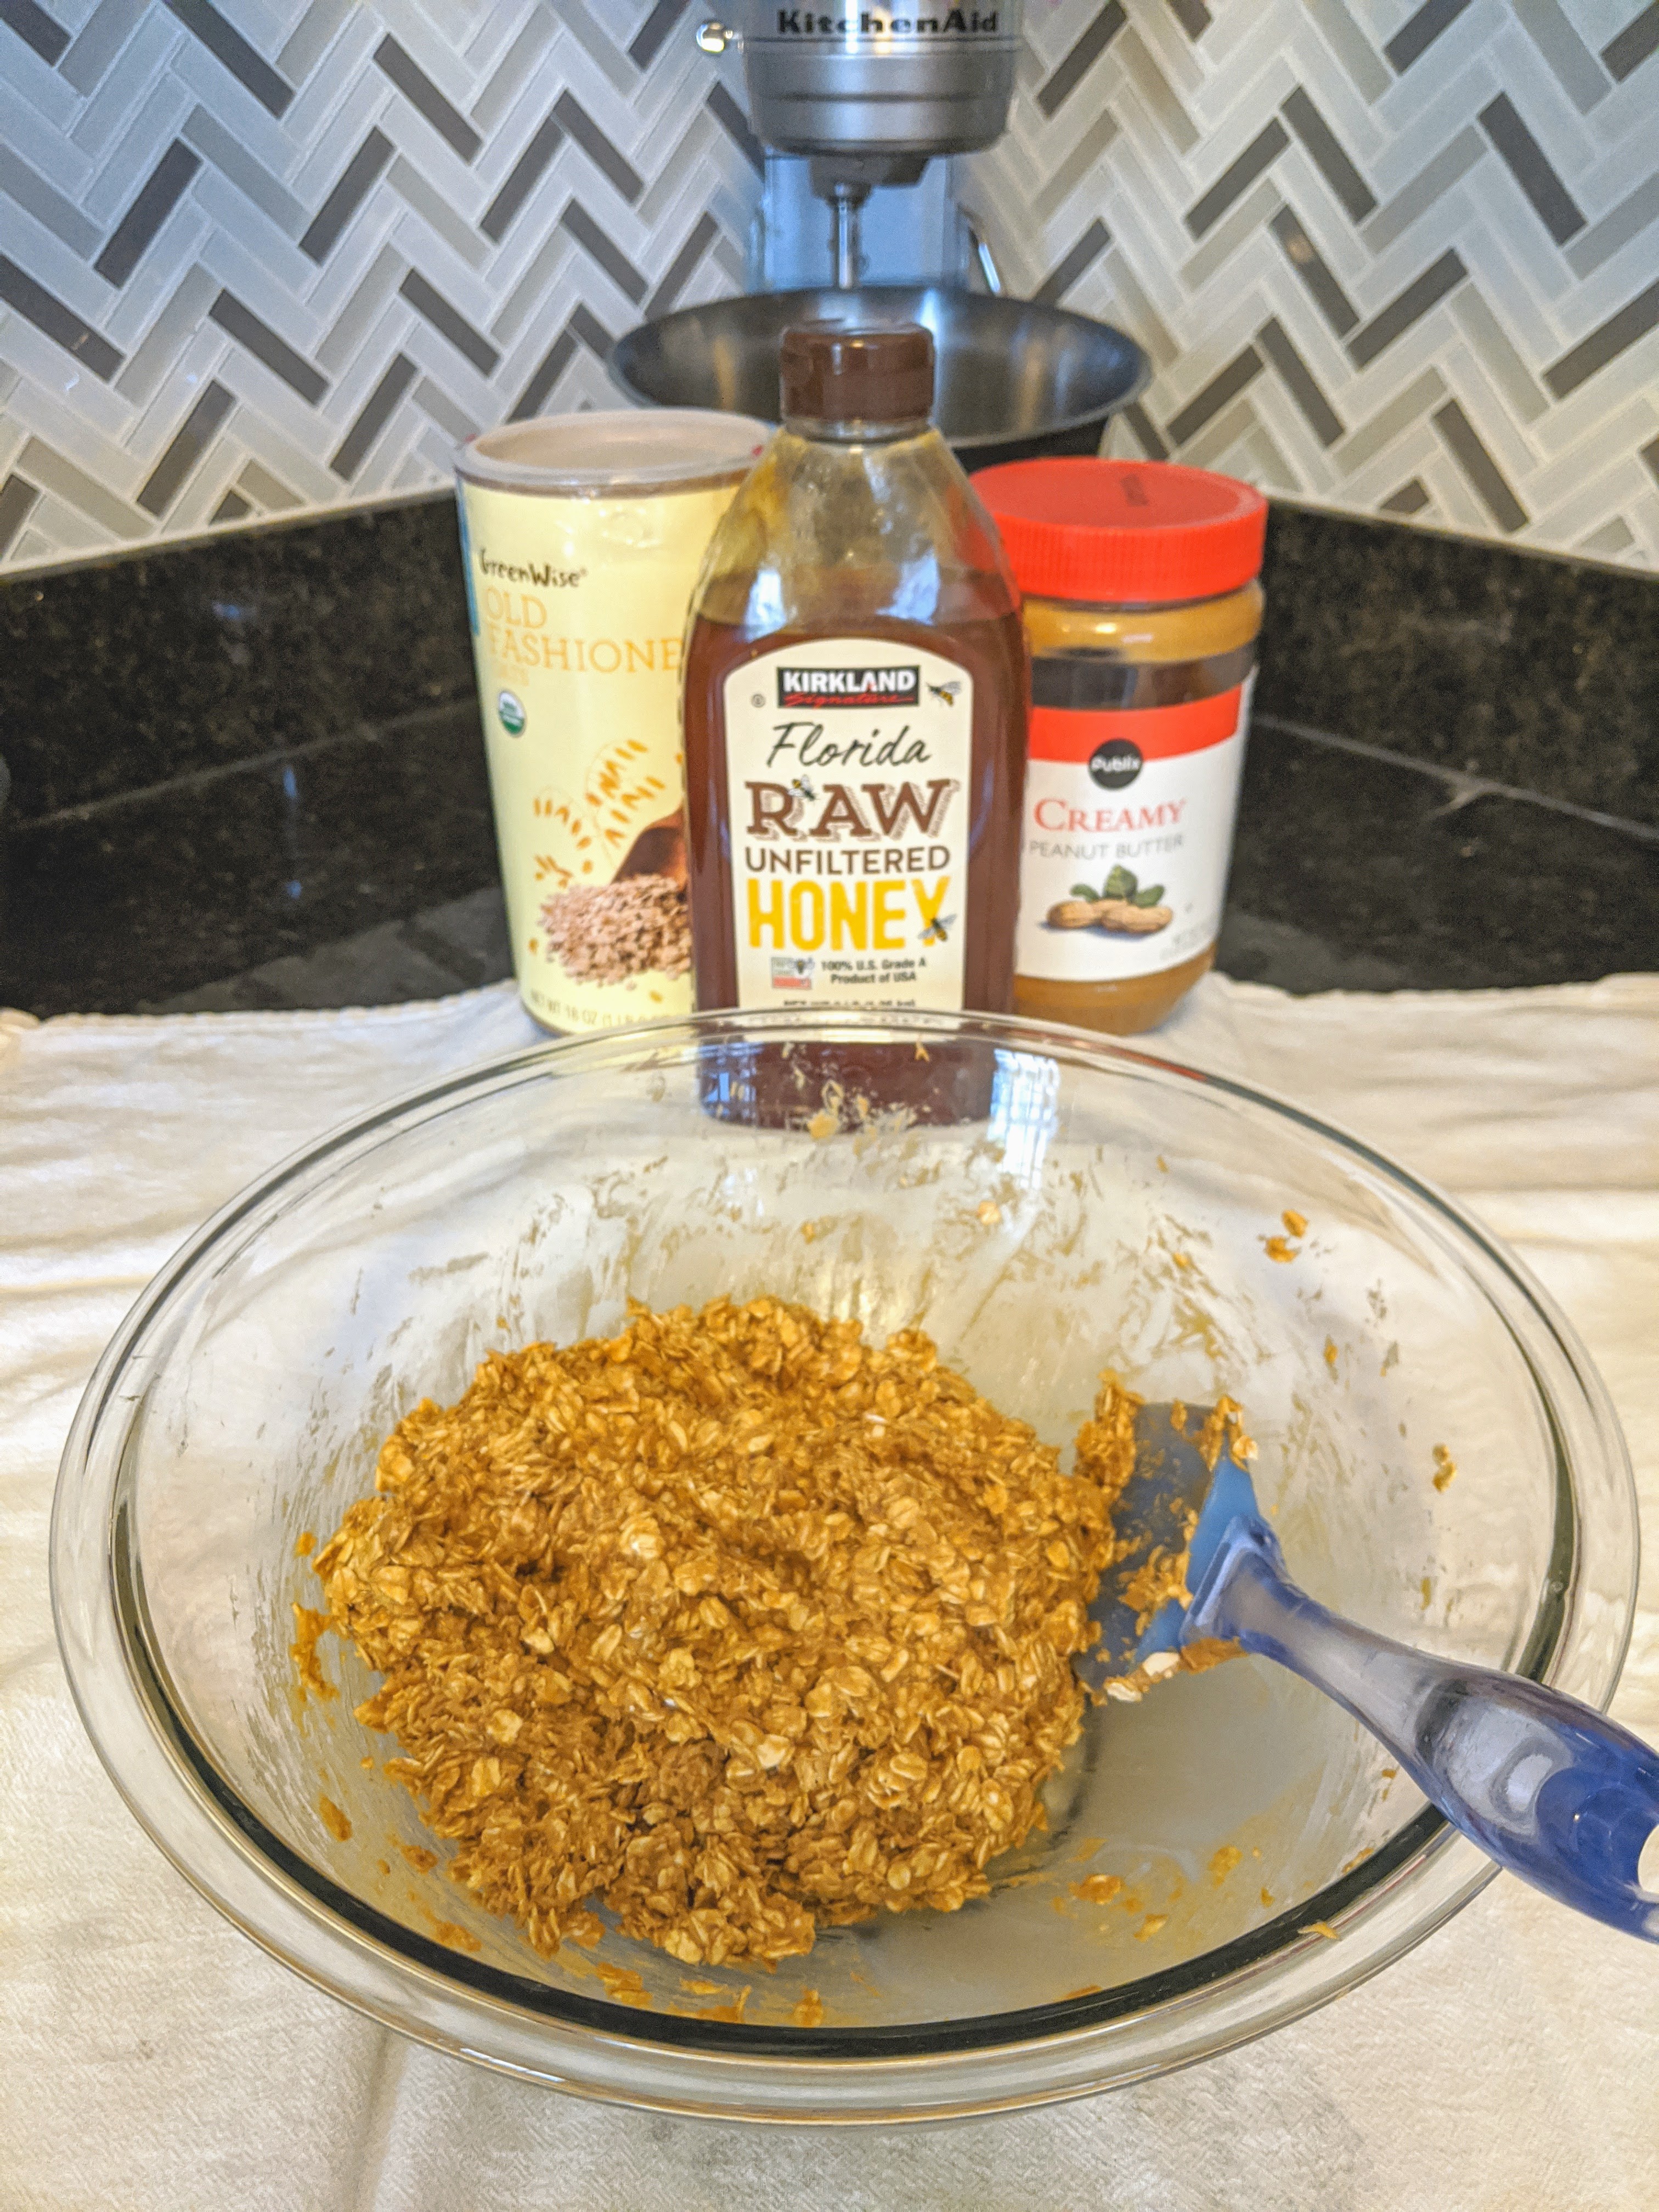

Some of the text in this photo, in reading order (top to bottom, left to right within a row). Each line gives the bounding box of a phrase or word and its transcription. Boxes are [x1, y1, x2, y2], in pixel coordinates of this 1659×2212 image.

[777, 9, 998, 33] KitchenAid
[484, 585, 548, 630] OLD
[783, 670, 917, 693] KIRKLAND
[783, 691, 915, 709] Signature
[766, 721, 932, 768] Florida
[1091, 754, 1140, 772] Publix
[744, 778, 960, 843] RAW
[1033, 798, 1187, 833] CREAMY
[745, 845, 951, 875] UNFILTERED
[1028, 833, 1185, 860] PEANUT BUTTER
[747, 876, 951, 951] HONEY
[881, 958, 916, 969] Grade
[919, 957, 927, 967] A
[831, 973, 875, 984] Product
[879, 972, 890, 983] of
